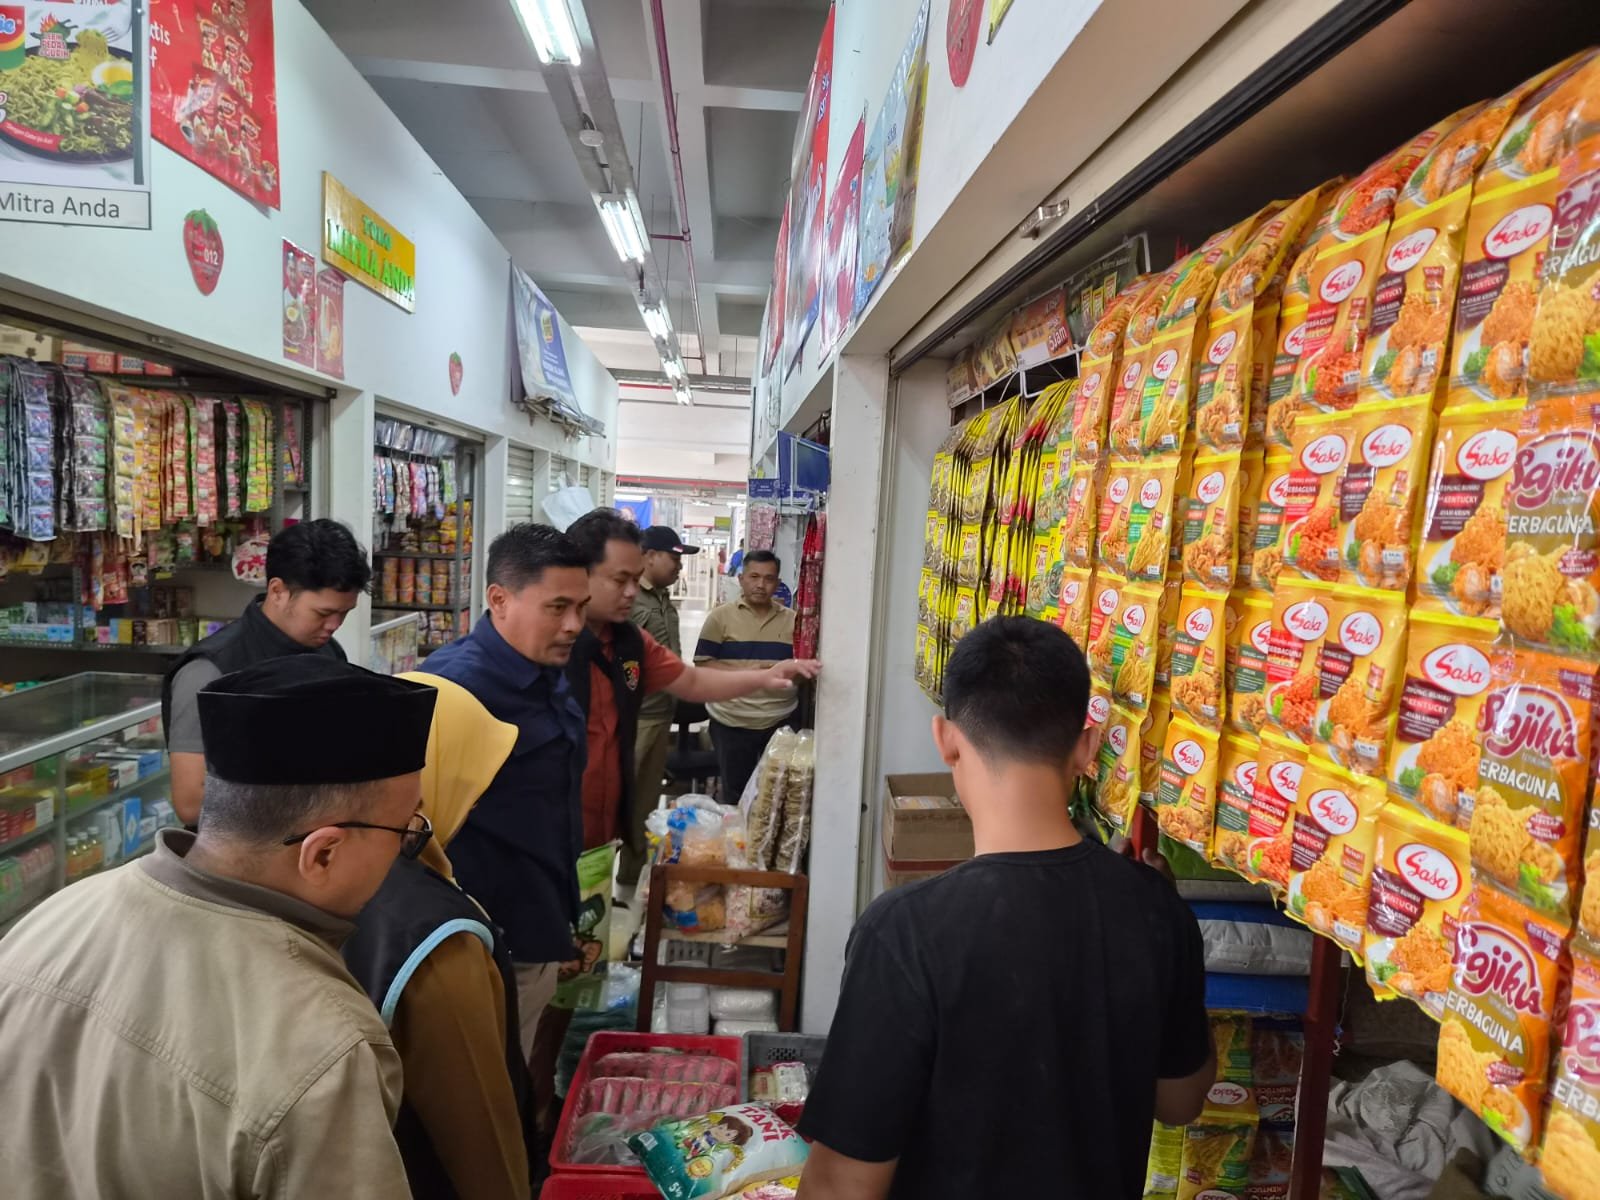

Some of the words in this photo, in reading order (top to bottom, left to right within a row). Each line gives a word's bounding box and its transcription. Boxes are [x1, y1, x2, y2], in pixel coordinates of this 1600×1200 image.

[0, 193, 54, 215] Mitra
[62, 196, 120, 219] Anda
[1492, 215, 1541, 250] Sasa
[327, 219, 379, 281] MITRA
[381, 258, 415, 302] ANDA
[1393, 233, 1427, 266] Sasa
[1471, 274, 1503, 291] KENTUCKY
[1310, 441, 1341, 466] Sasa
[1369, 430, 1404, 458] Sasa
[1465, 437, 1510, 468] Sasa
[1443, 495, 1478, 504] KENTUCKY
[1509, 514, 1595, 535] ERBAGUNA
[1291, 606, 1322, 632] Sasa
[1345, 616, 1376, 646] Sasa
[1435, 650, 1484, 684] Sasa
[1408, 697, 1449, 715] KENTUCKY
[1480, 759, 1561, 802] ERBAGUNA
[1318, 795, 1349, 827] Sasa
[1295, 831, 1325, 850] KENTUCKY
[1406, 851, 1449, 890] Sasa
[1380, 891, 1418, 914] KENTUCKY
[1446, 990, 1524, 1054] ERBAGUNA
[1213, 1086, 1242, 1101] Sasa
[737, 1105, 781, 1143] TANI
